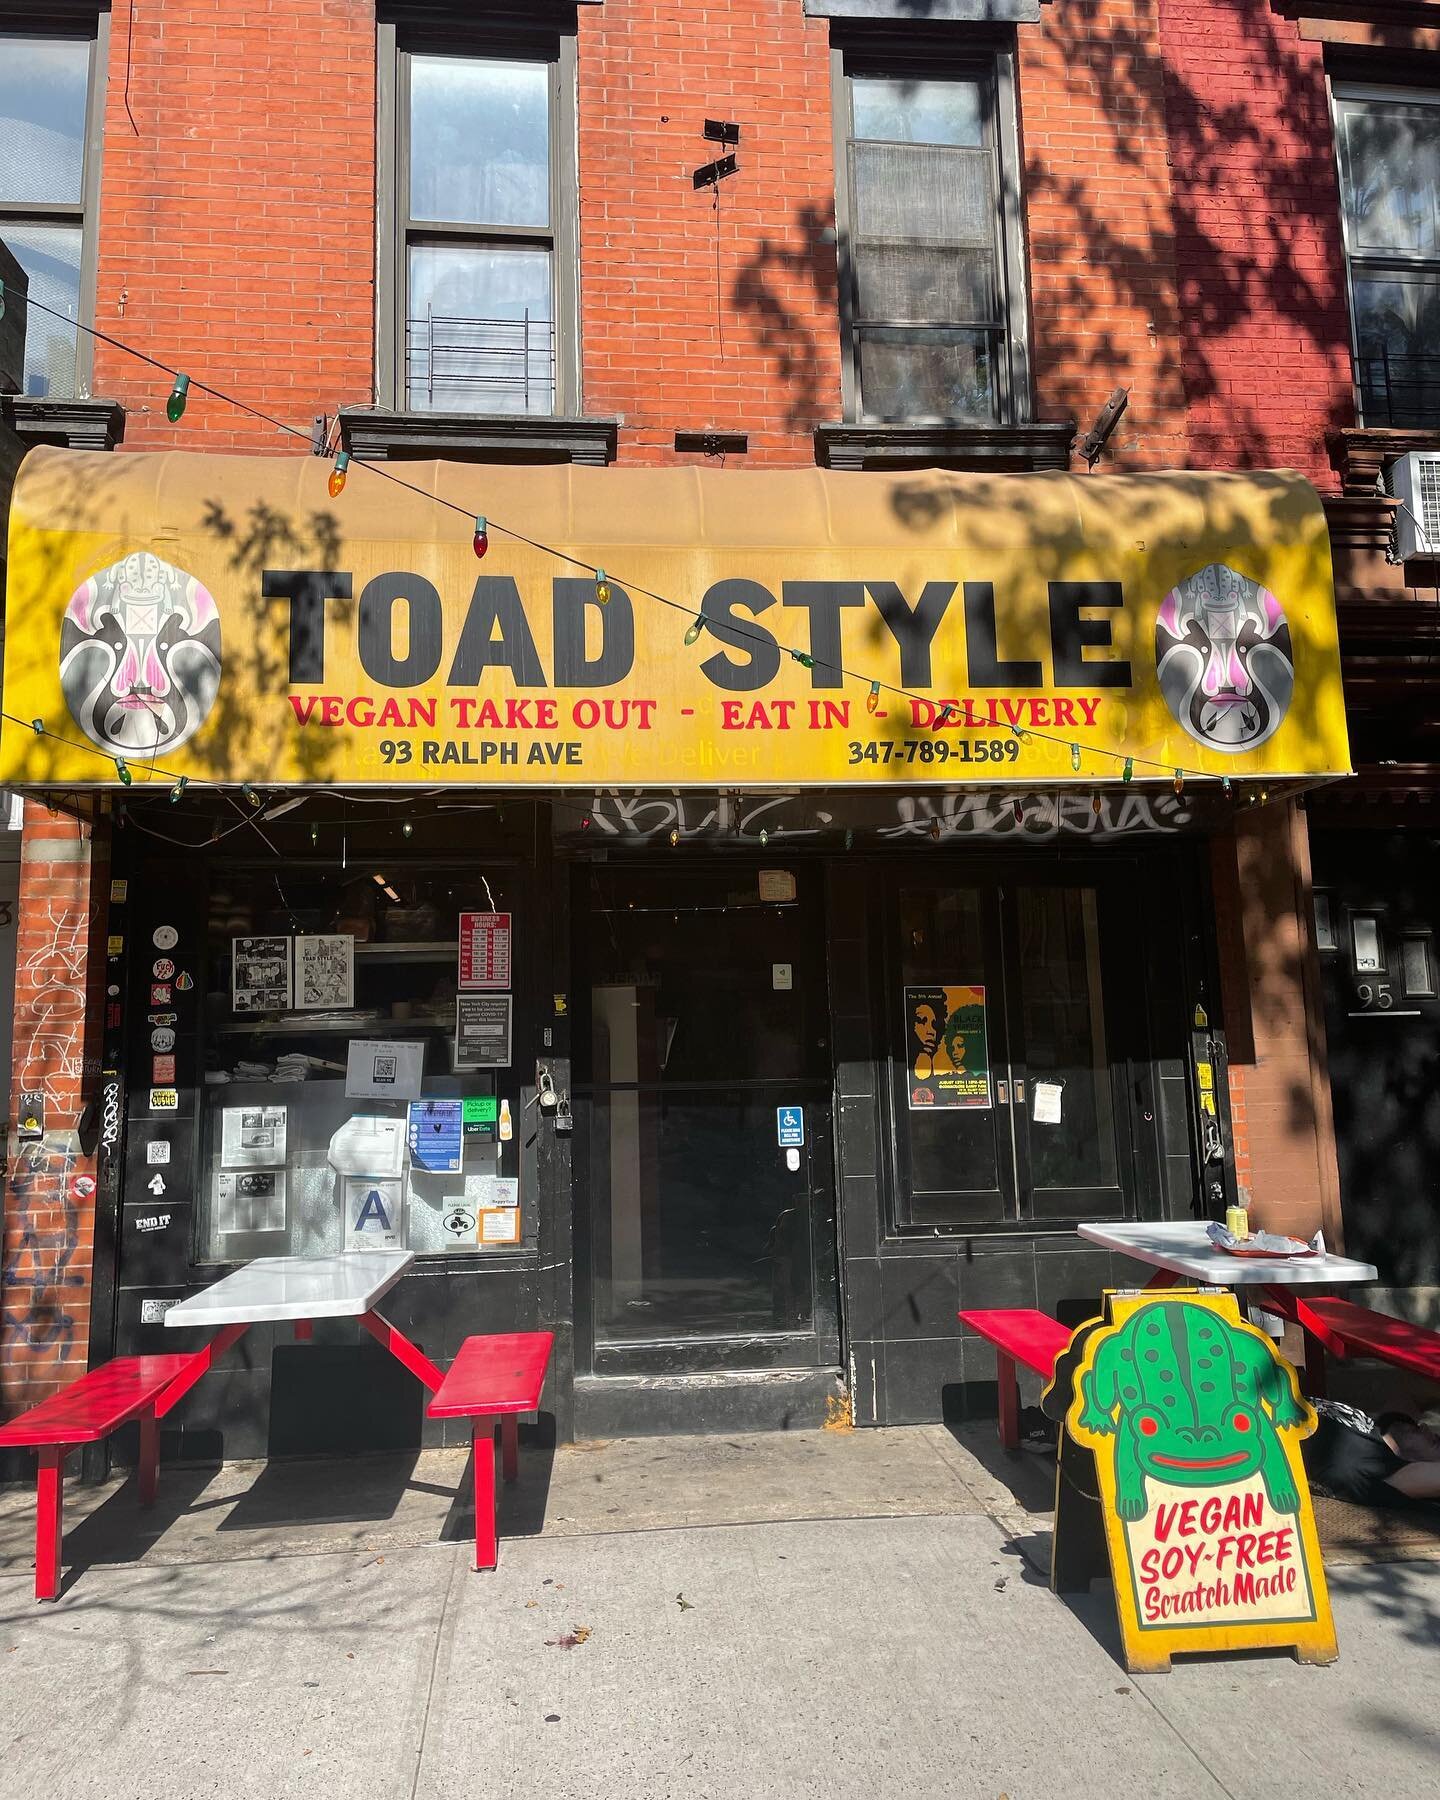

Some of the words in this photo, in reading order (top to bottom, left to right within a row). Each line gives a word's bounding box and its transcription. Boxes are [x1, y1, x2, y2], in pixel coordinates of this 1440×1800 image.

[262, 570, 634, 689] TOAD
[699, 579, 1132, 691] STYLE
[287, 696, 437, 728] VEGAN
[450, 698, 559, 730] TAKE
[572, 699, 657, 730] OUT
[721, 700, 796, 730] EAT
[808, 700, 851, 730] IN
[909, 697, 1101, 731] DELIVERY
[379, 740, 412, 765] 93
[422, 741, 518, 765] RALPH
[526, 742, 584, 766] AVE
[848, 740, 1019, 764] 347-789-1589
[1356, 984, 1394, 1009] 95
[135, 1216, 158, 1230] END
[158, 1214, 171, 1226] IT
[354, 1190, 392, 1231] A
[1154, 1492, 1264, 1543] VEGAN
[1140, 1527, 1294, 1584] SOY-FREE
[1144, 1577, 1233, 1621] Scratch
[1233, 1565, 1297, 1606] Made
